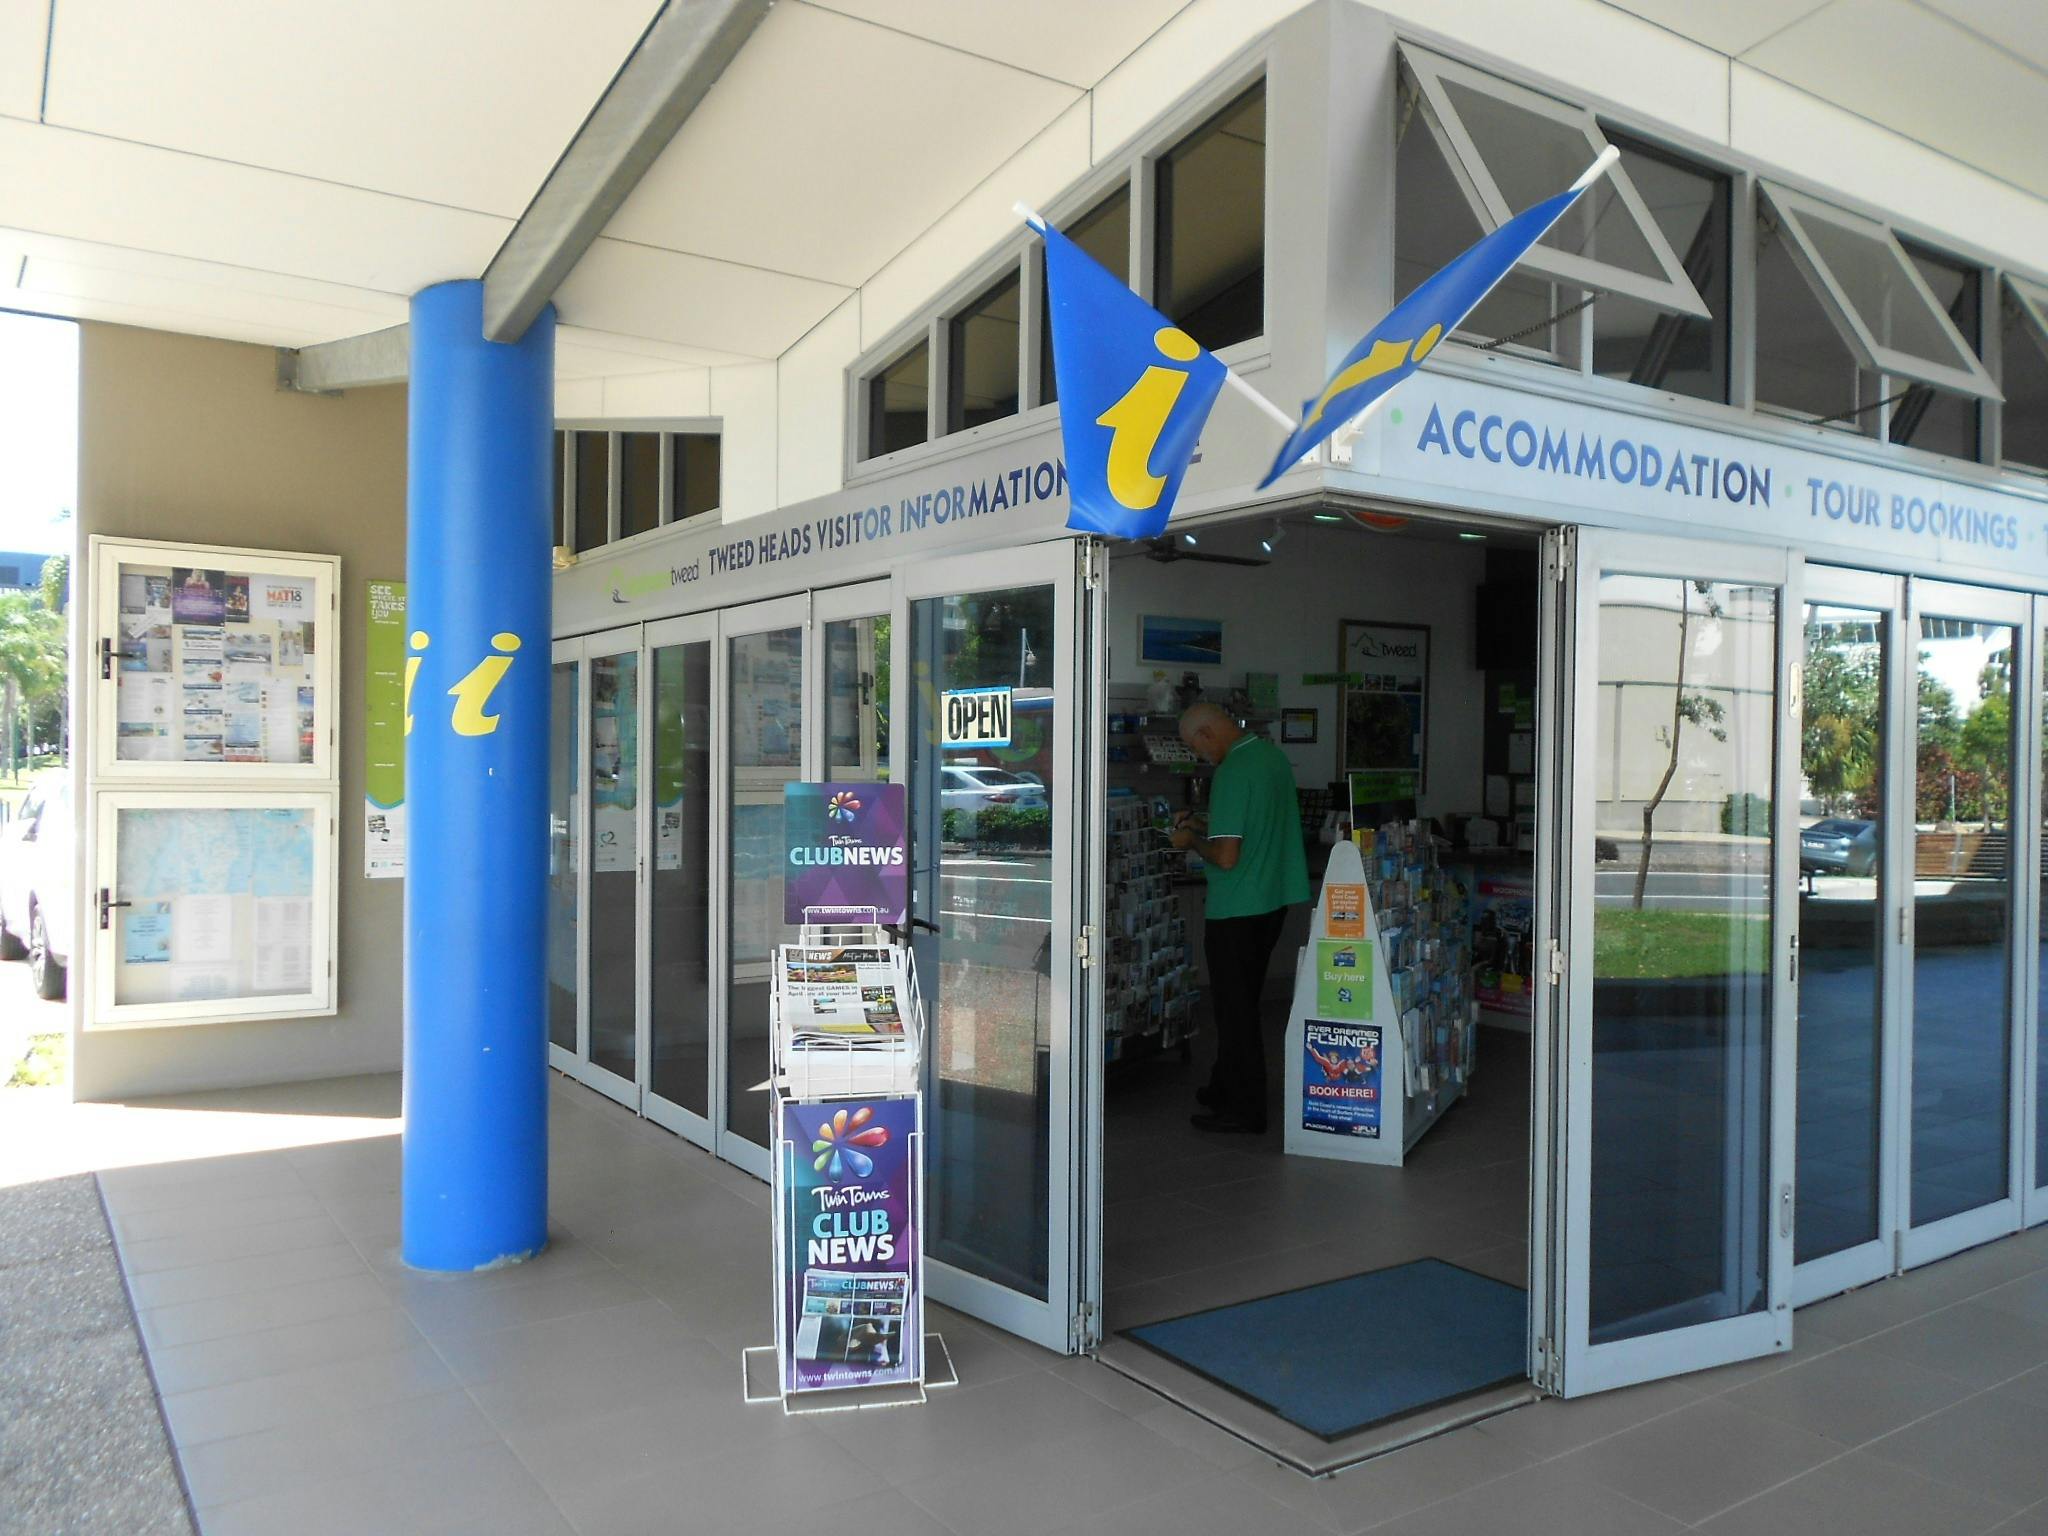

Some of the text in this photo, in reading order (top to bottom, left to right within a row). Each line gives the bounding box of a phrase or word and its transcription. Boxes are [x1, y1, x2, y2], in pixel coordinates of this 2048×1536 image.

[1417, 402, 1771, 508] ACCOMMODATION
[1807, 478, 1880, 527] TOUR
[1891, 494, 2018, 550] BOOKINGS
[709, 539, 754, 576] TWEED
[759, 524, 812, 565] HEADS
[817, 504, 892, 551] VISITOR
[671, 558, 699, 586] tweed
[370, 585, 392, 595] SEE
[370, 600, 405, 611] TAKES
[1382, 642, 1417, 657] tweed
[947, 695, 1007, 741] OPEN
[790, 846, 904, 865] CLUBNEWS
[1323, 971, 1365, 984] Buy here
[1307, 1025, 1379, 1038] EVER DREAMED
[1307, 1032, 1379, 1048] FLYING?
[1309, 1085, 1374, 1098] BOOK HERE!
[811, 1185, 890, 1212] Twin Towns
[813, 1209, 889, 1238] CLUB
[808, 1234, 894, 1265] NEWS
[798, 1366, 905, 1382] www.twintowns.com.au
